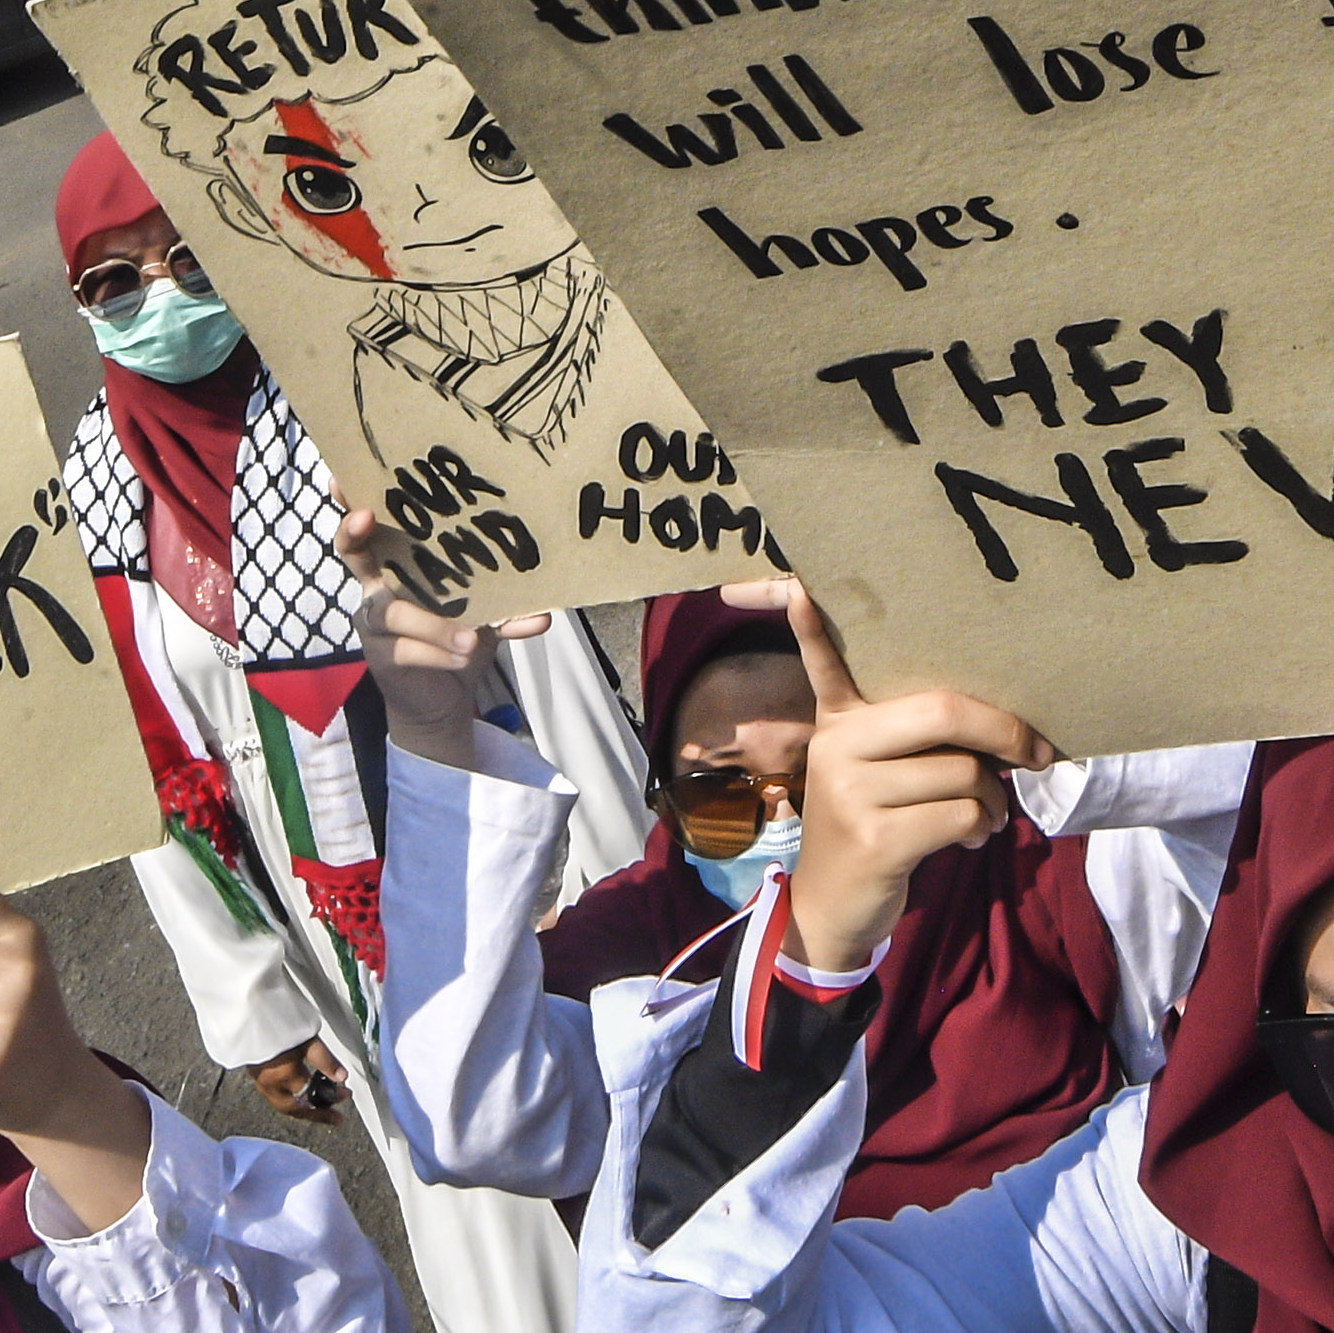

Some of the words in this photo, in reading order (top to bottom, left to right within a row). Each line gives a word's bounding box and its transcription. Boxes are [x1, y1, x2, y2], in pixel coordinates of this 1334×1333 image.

[603, 53, 864, 170] will
[969, 15, 1219, 116] lose
[697, 193, 1081, 292] hopes.
[817, 308, 1228, 446] THEY
[385, 445, 506, 541] OUR
[579, 481, 793, 572] HOM
[384, 510, 541, 618] LAND
